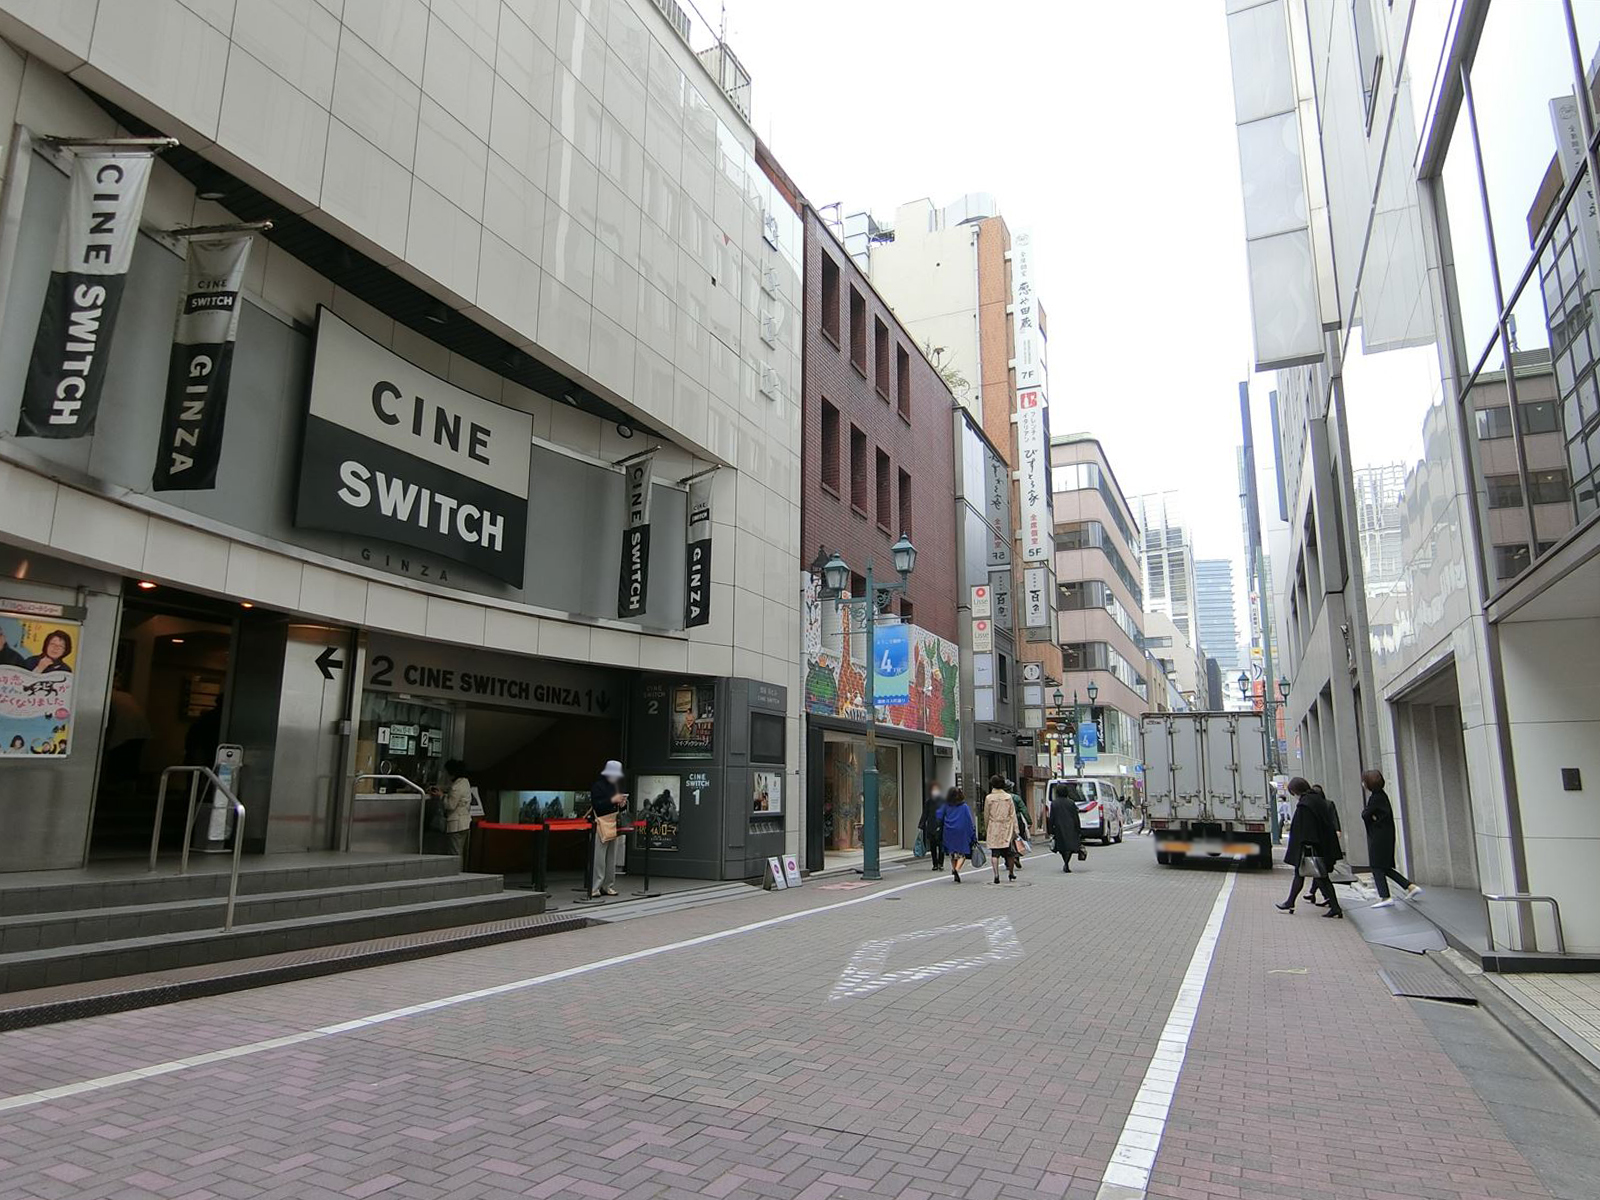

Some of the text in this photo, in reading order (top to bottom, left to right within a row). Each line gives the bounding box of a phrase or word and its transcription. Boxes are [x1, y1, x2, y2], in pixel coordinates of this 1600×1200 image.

[49, 163, 125, 425] CINE SWITCH
[197, 278, 228, 289] CINE
[191, 295, 234, 308] SWITCH
[1021, 369, 1035, 380] 7F
[169, 354, 213, 475] GINZA
[371, 380, 492, 466] CINE
[337, 460, 505, 552] SWITCH
[629, 466, 643, 611] CINE SWITCH
[1028, 547, 1042, 557] 5F
[361, 548, 449, 582] GINZA
[690, 547, 702, 619] GINZA
[370, 655, 593, 712] 2 CINE SWITCH GINZA 1
[648, 700, 659, 714] 2
[381, 729, 387, 740] 1
[422, 733, 428, 746] 2
[692, 789, 700, 806] 1
